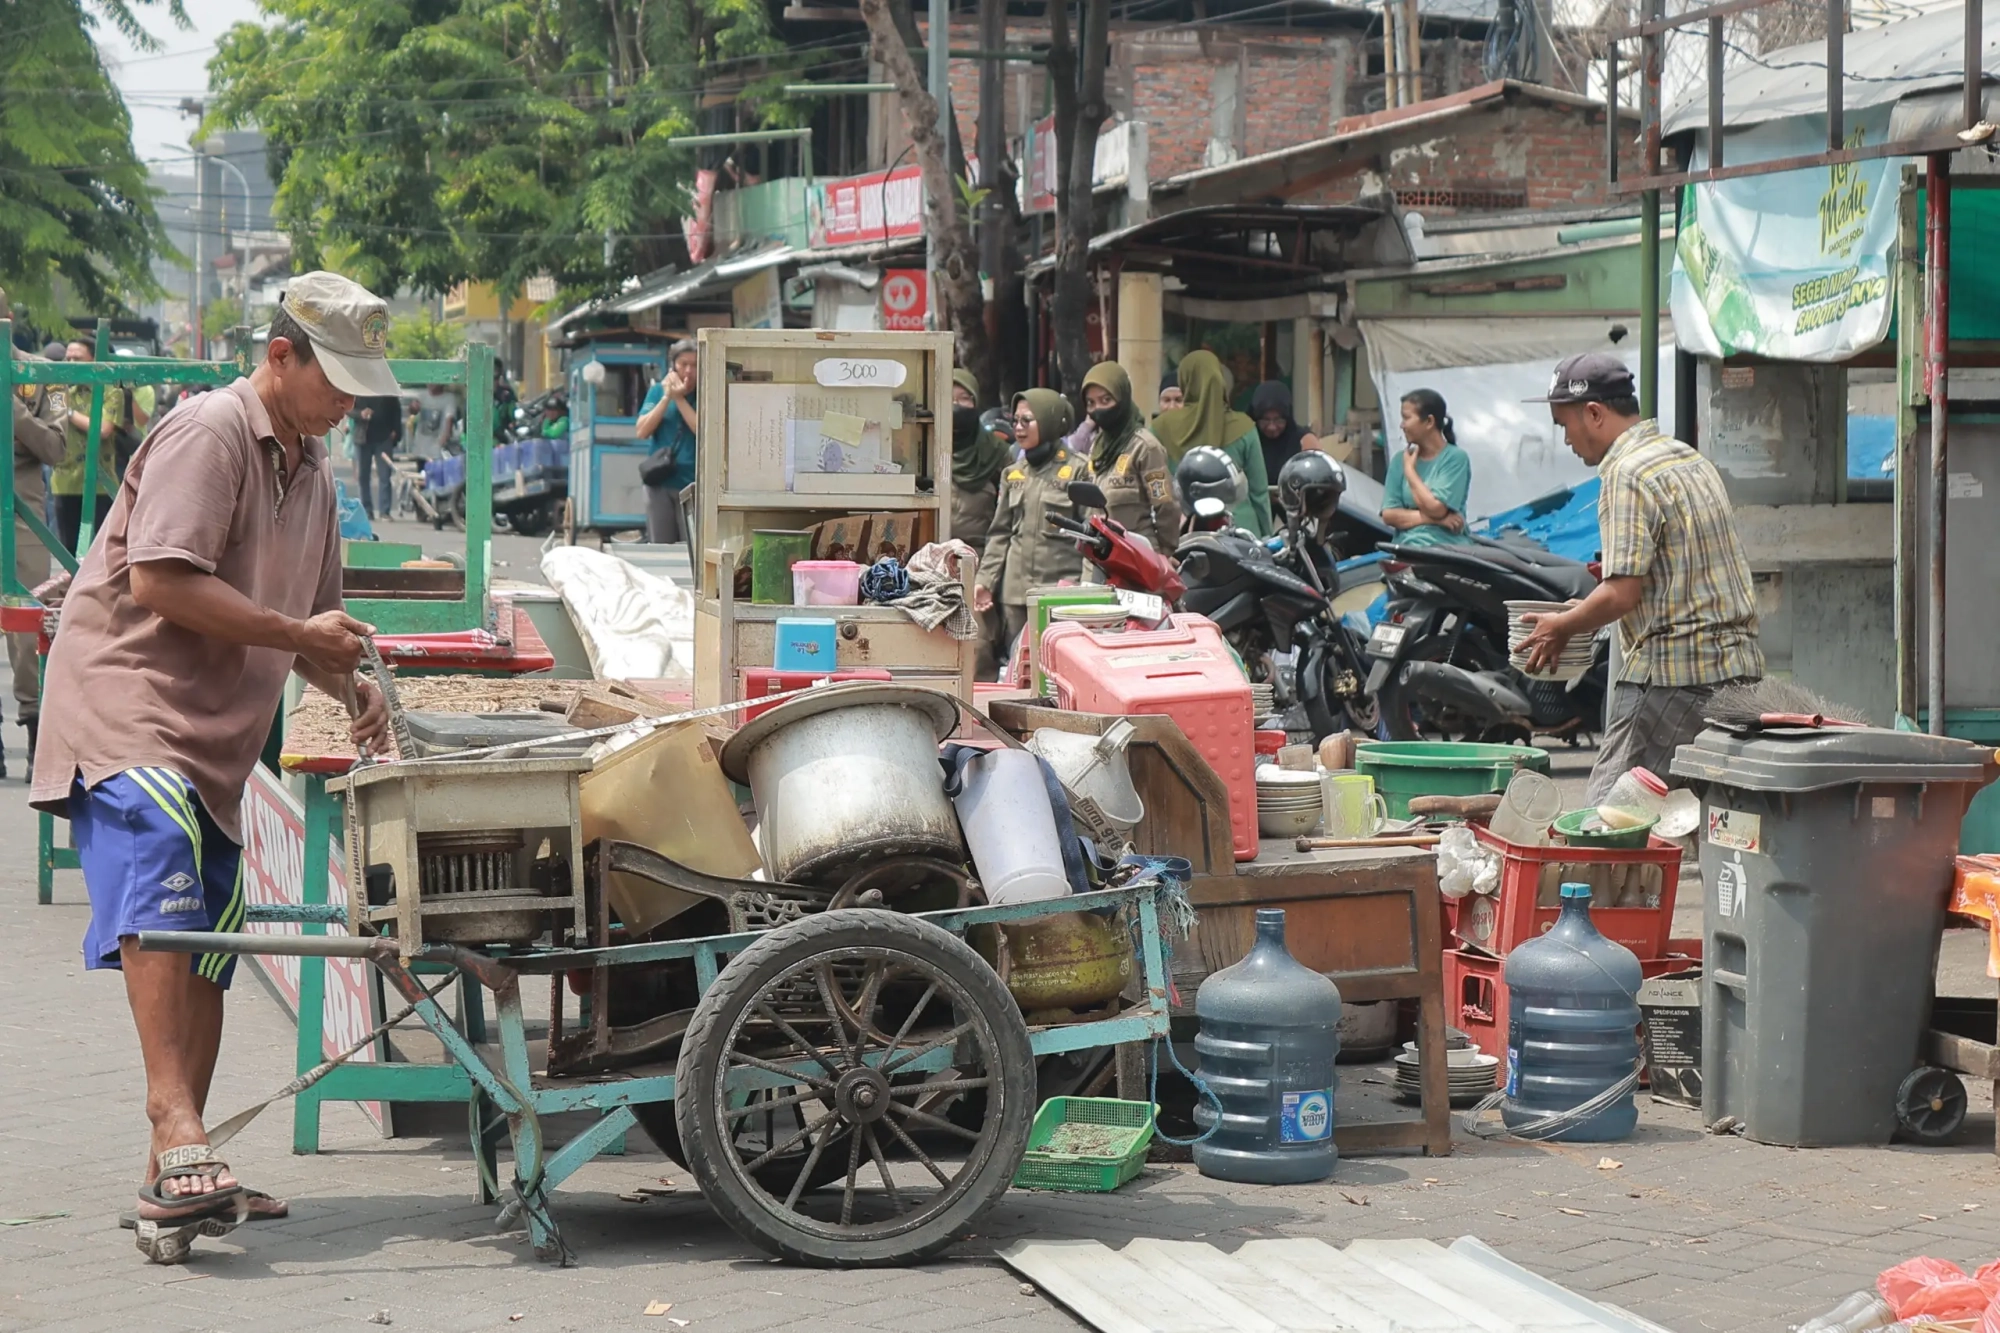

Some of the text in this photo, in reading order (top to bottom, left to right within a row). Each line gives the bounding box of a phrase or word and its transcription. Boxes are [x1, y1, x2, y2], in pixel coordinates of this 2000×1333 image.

[1820, 169, 1866, 253] Madu
[1792, 276, 1829, 310] SEGER
[1794, 300, 1839, 336] SMOOTH
[838, 361, 877, 381] 3000
[1146, 595, 1160, 609] TE
[1079, 797, 1105, 828] norm
[349, 814, 362, 887] Bahnnorm
[159, 896, 200, 914] lotto
[1647, 987, 1684, 999] ADVANCE
[1301, 1112, 1326, 1127] AQUA
[161, 1147, 215, 1168] 12195-2
